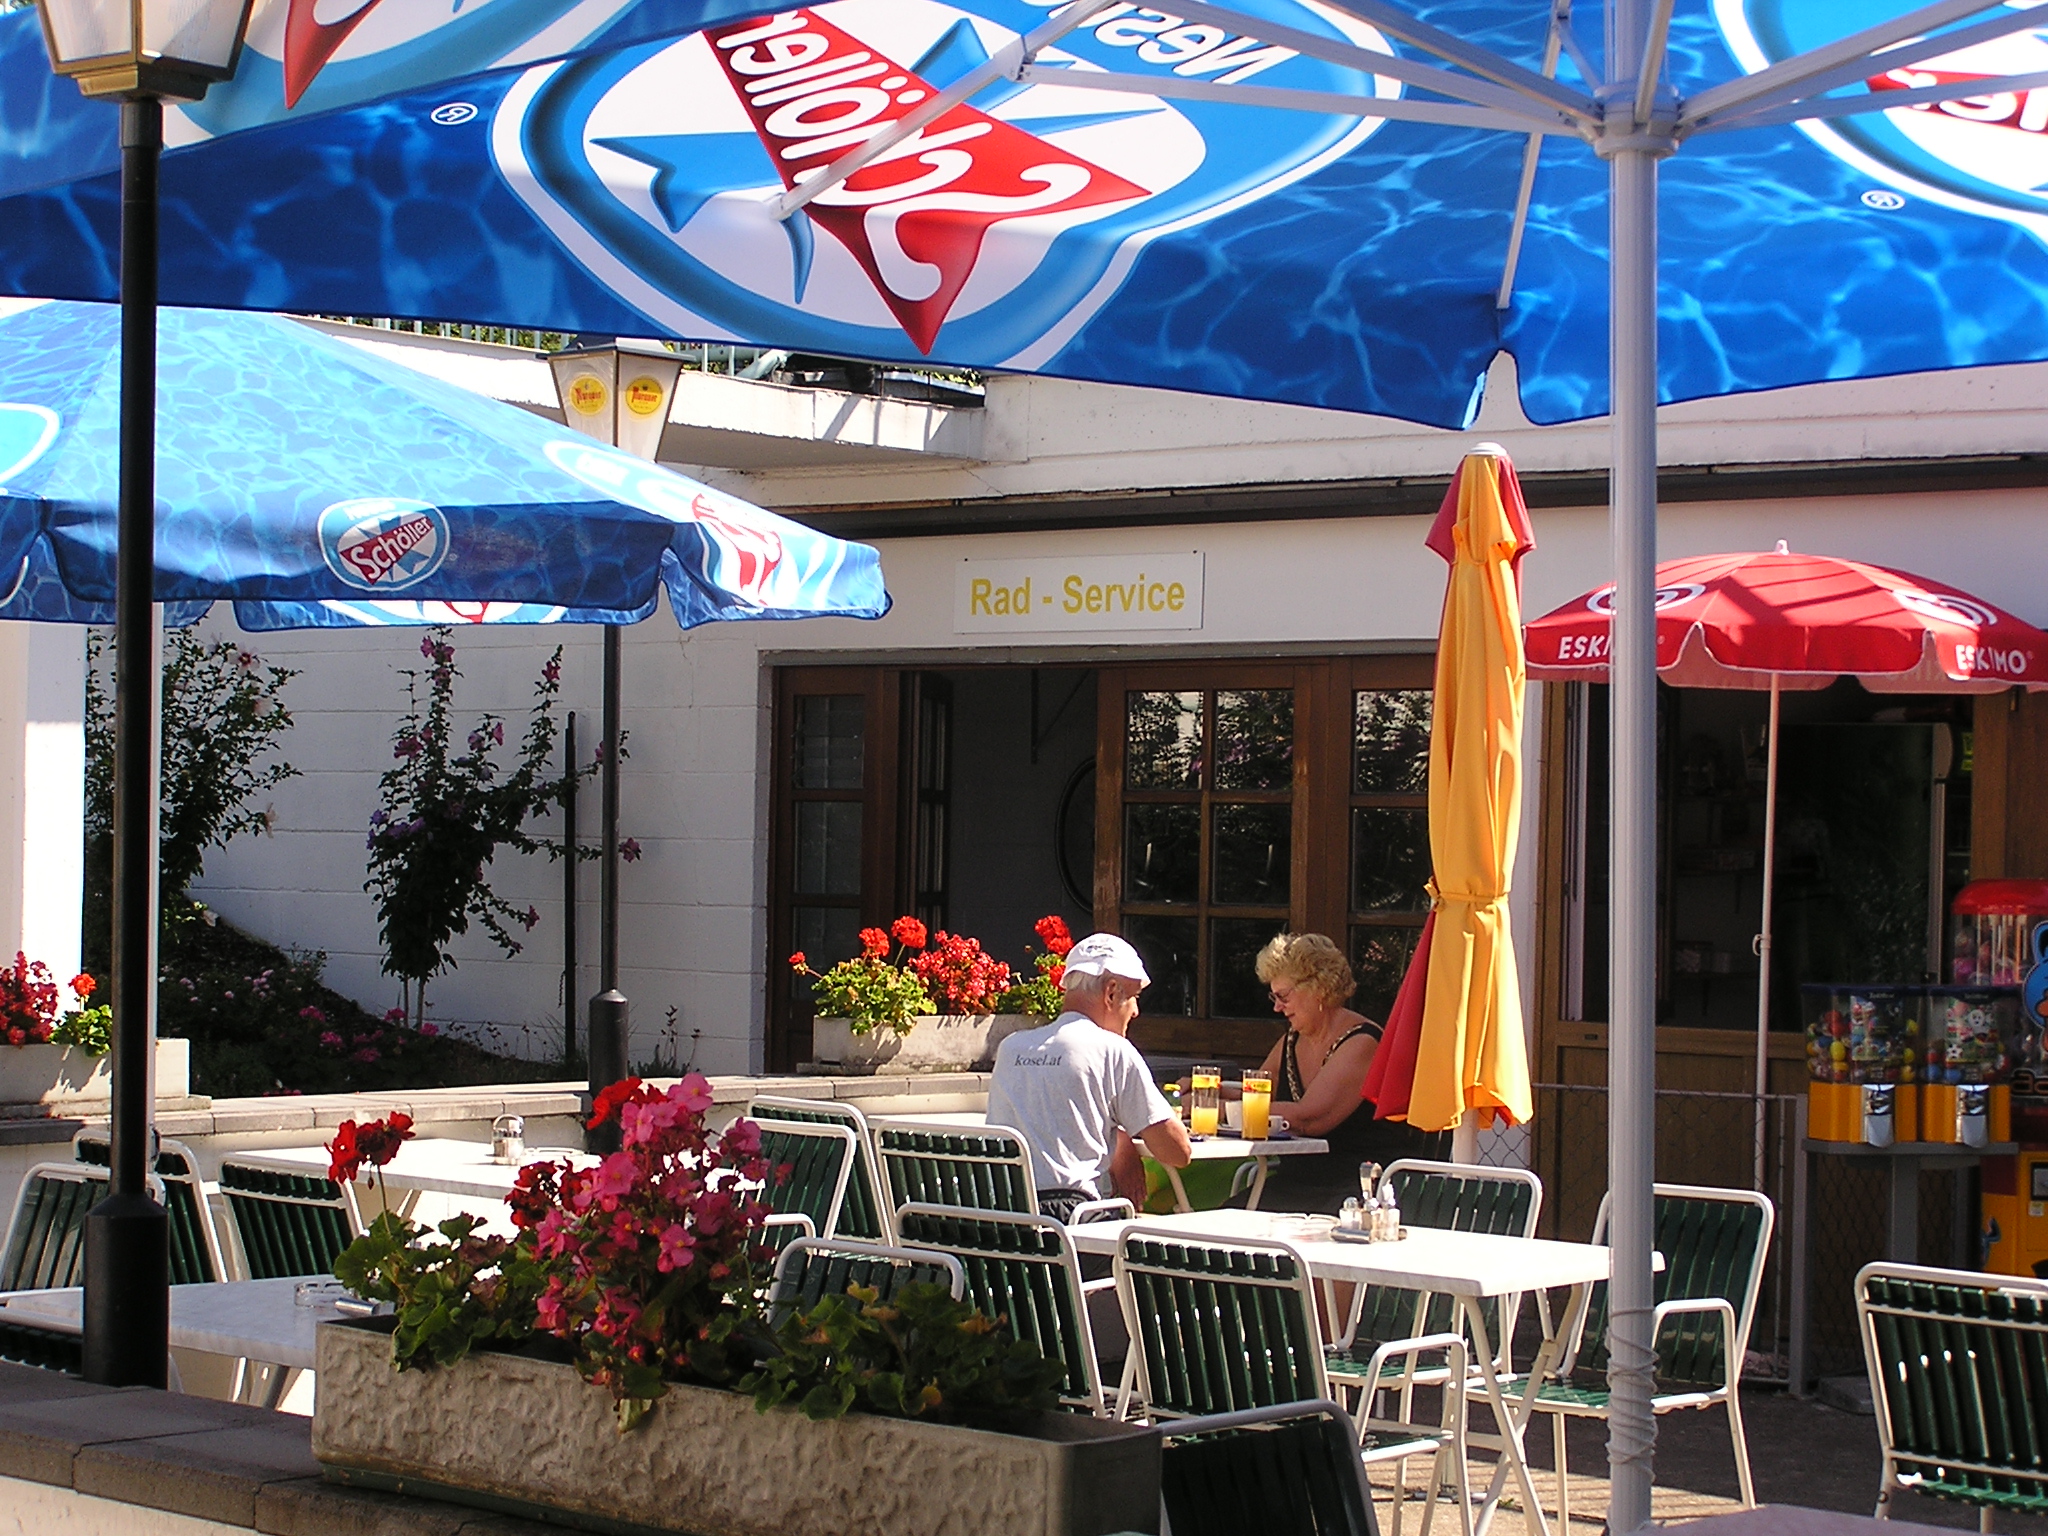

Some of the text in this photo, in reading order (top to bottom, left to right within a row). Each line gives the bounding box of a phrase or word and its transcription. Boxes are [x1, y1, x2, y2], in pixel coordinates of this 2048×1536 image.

[350, 516, 431, 580] Schöller
[970, 576, 1031, 616] Rad
[1062, 573, 1185, 614] Service
[1558, 635, 1612, 660] ESKI
[1955, 644, 2027, 674] ESKIMO
[1014, 1054, 1062, 1067] kosel.at
